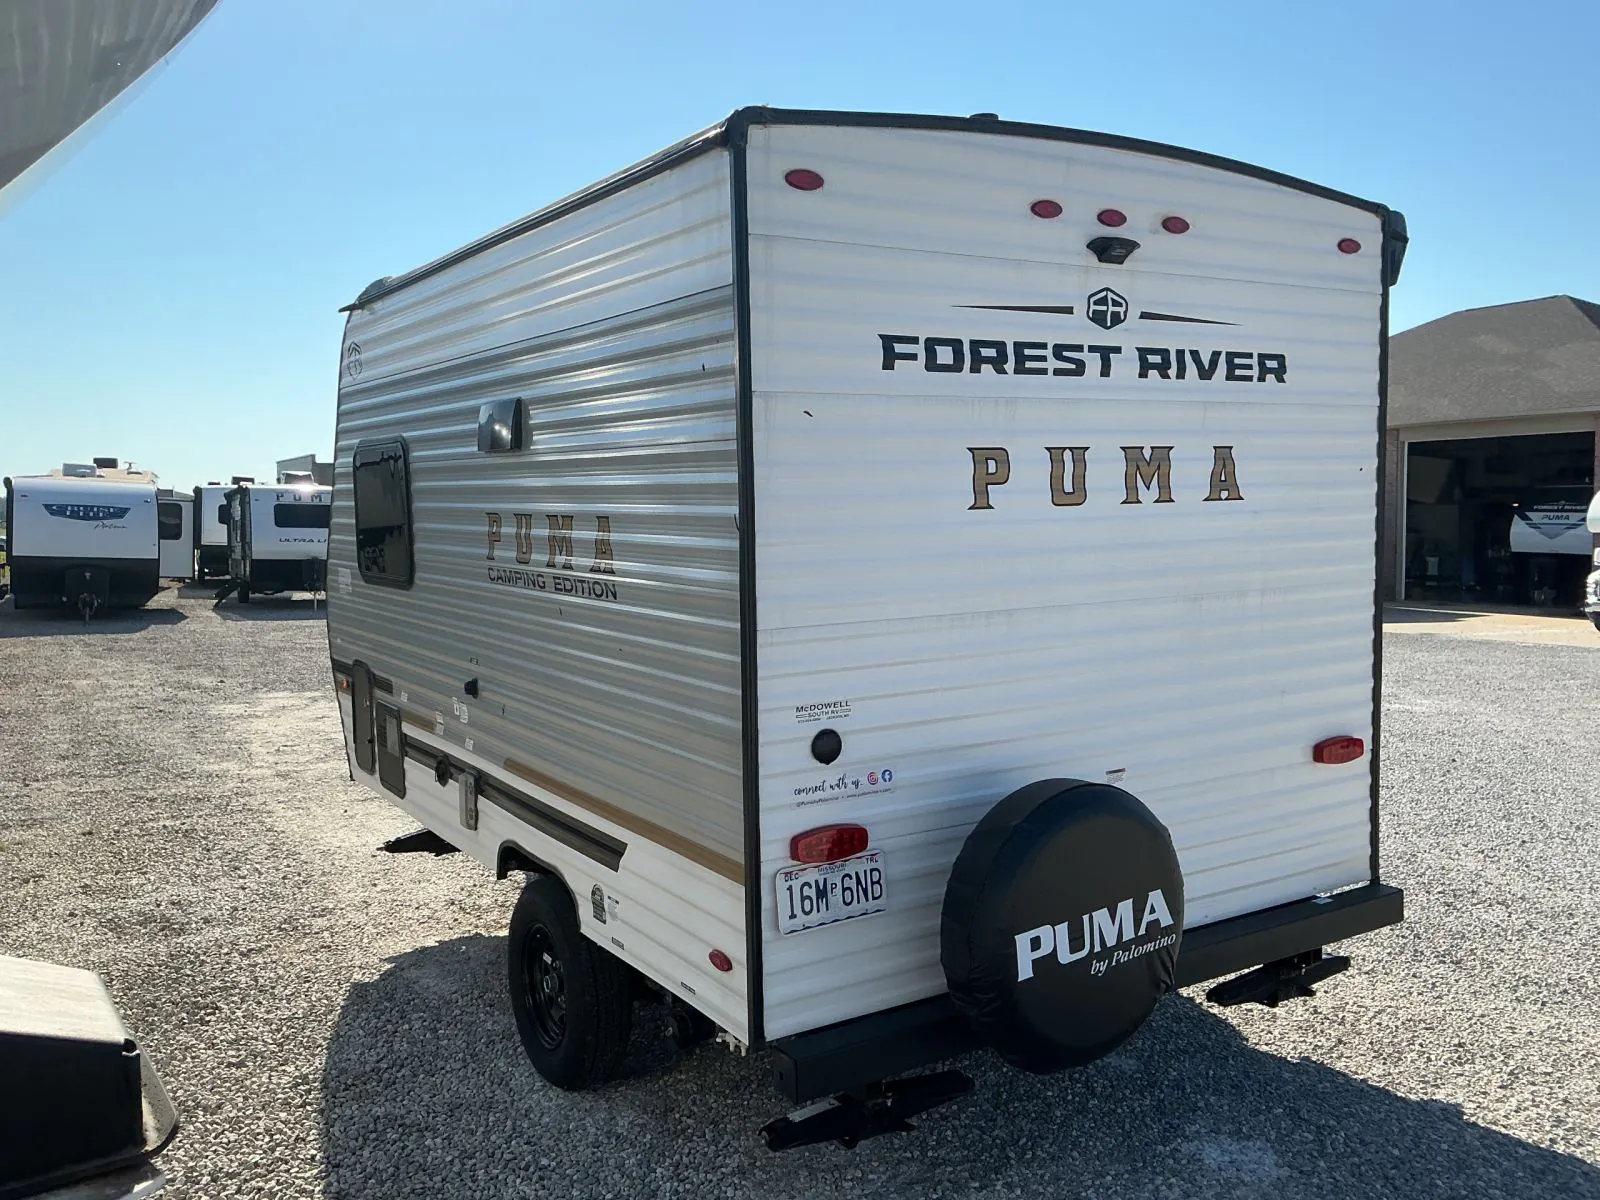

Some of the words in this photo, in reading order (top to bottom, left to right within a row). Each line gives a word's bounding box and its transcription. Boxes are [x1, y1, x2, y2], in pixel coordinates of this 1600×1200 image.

[877, 333, 1122, 378] FOREST
[1135, 346, 1288, 384] RIVER
[966, 445, 1245, 510] PUMA
[485, 512, 616, 574] PUMA
[487, 567, 546, 590] CAMPING
[552, 575, 618, 601] EDITION
[795, 700, 851, 713] McDOWELL
[808, 710, 829, 718] SOUTH
[793, 780, 826, 796] connect
[829, 773, 848, 791] with
[817, 863, 847, 873] MISSOURI
[866, 857, 879, 865] TRL
[784, 872, 800, 883] DEC
[1014, 889, 1174, 982] PUMA
[1090, 959, 1108, 977] by
[1111, 933, 1176, 967] Palomino
